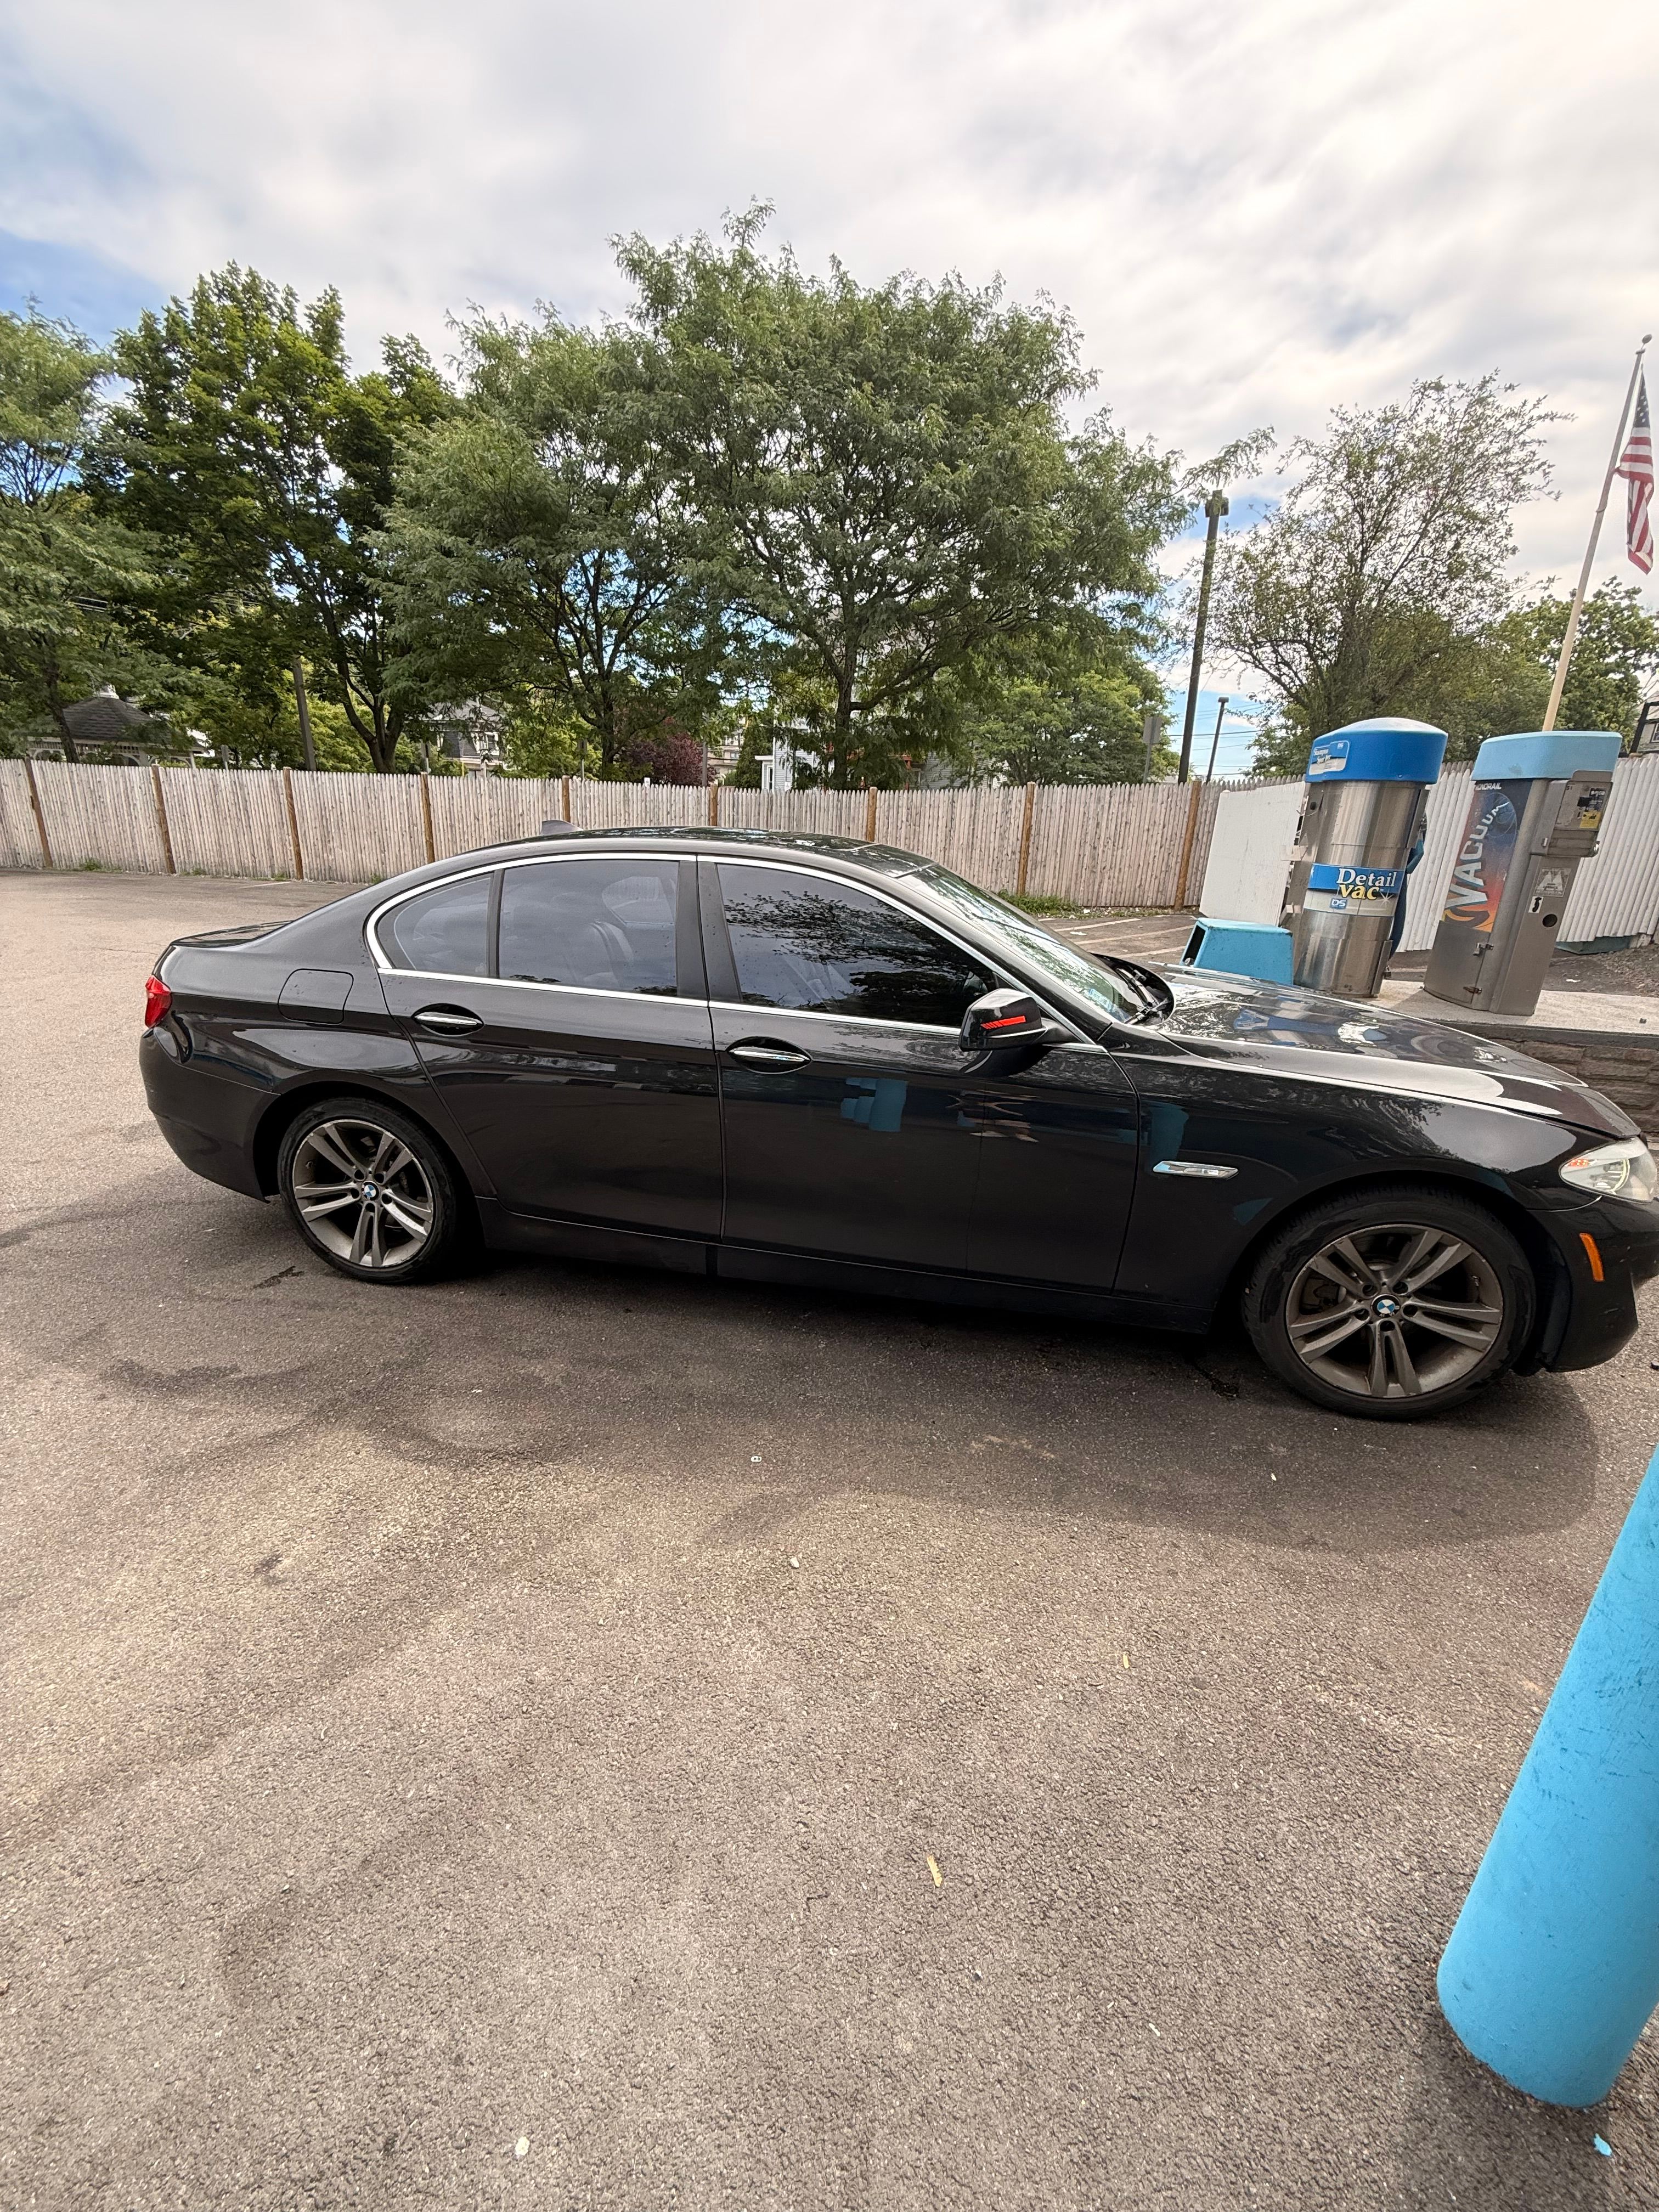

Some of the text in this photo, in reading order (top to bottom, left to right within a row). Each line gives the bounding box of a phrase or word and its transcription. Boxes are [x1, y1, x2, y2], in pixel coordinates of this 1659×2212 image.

[1444, 801, 1509, 909] VACUUM
[1336, 868, 1397, 887] Detail
[1339, 884, 1380, 900] vac
[1331, 899, 1346, 907] DS
